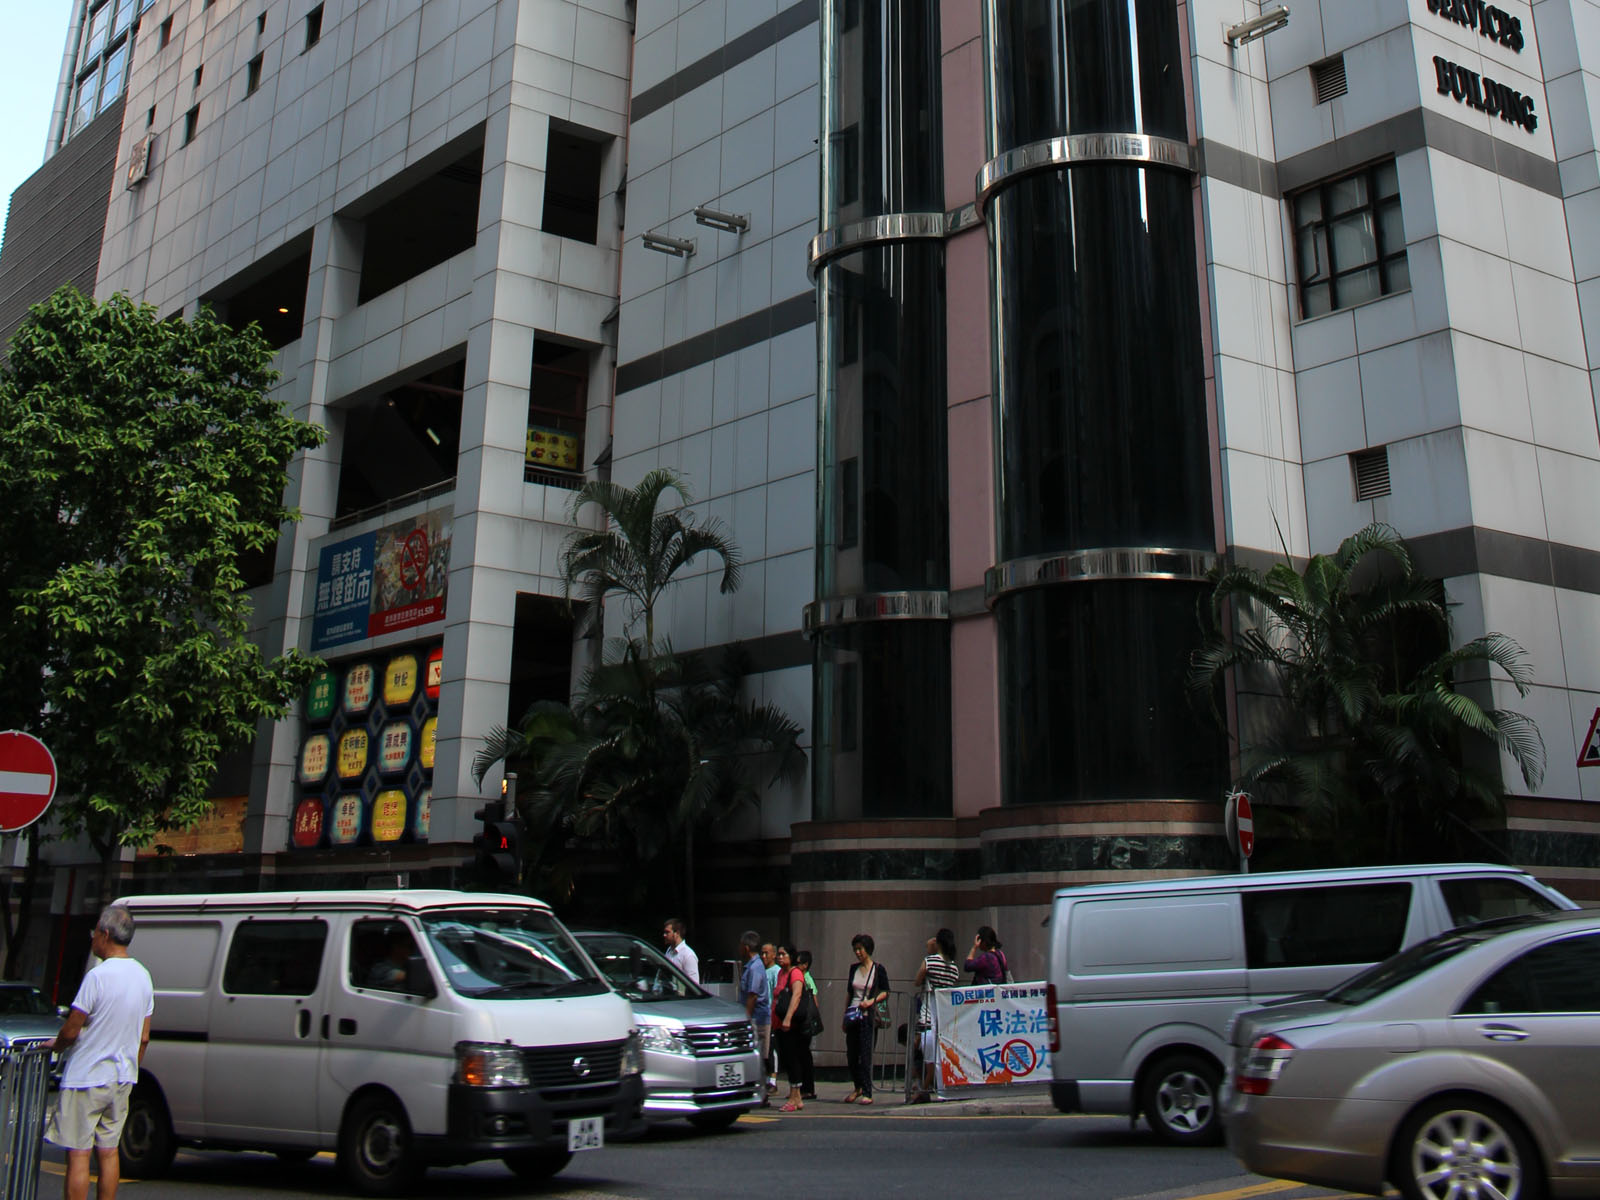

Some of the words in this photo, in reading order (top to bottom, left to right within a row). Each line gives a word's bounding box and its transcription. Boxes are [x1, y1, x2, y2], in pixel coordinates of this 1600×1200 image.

[1433, 55, 1539, 133] BUILDING
[317, 569, 372, 611] 無煙街市
